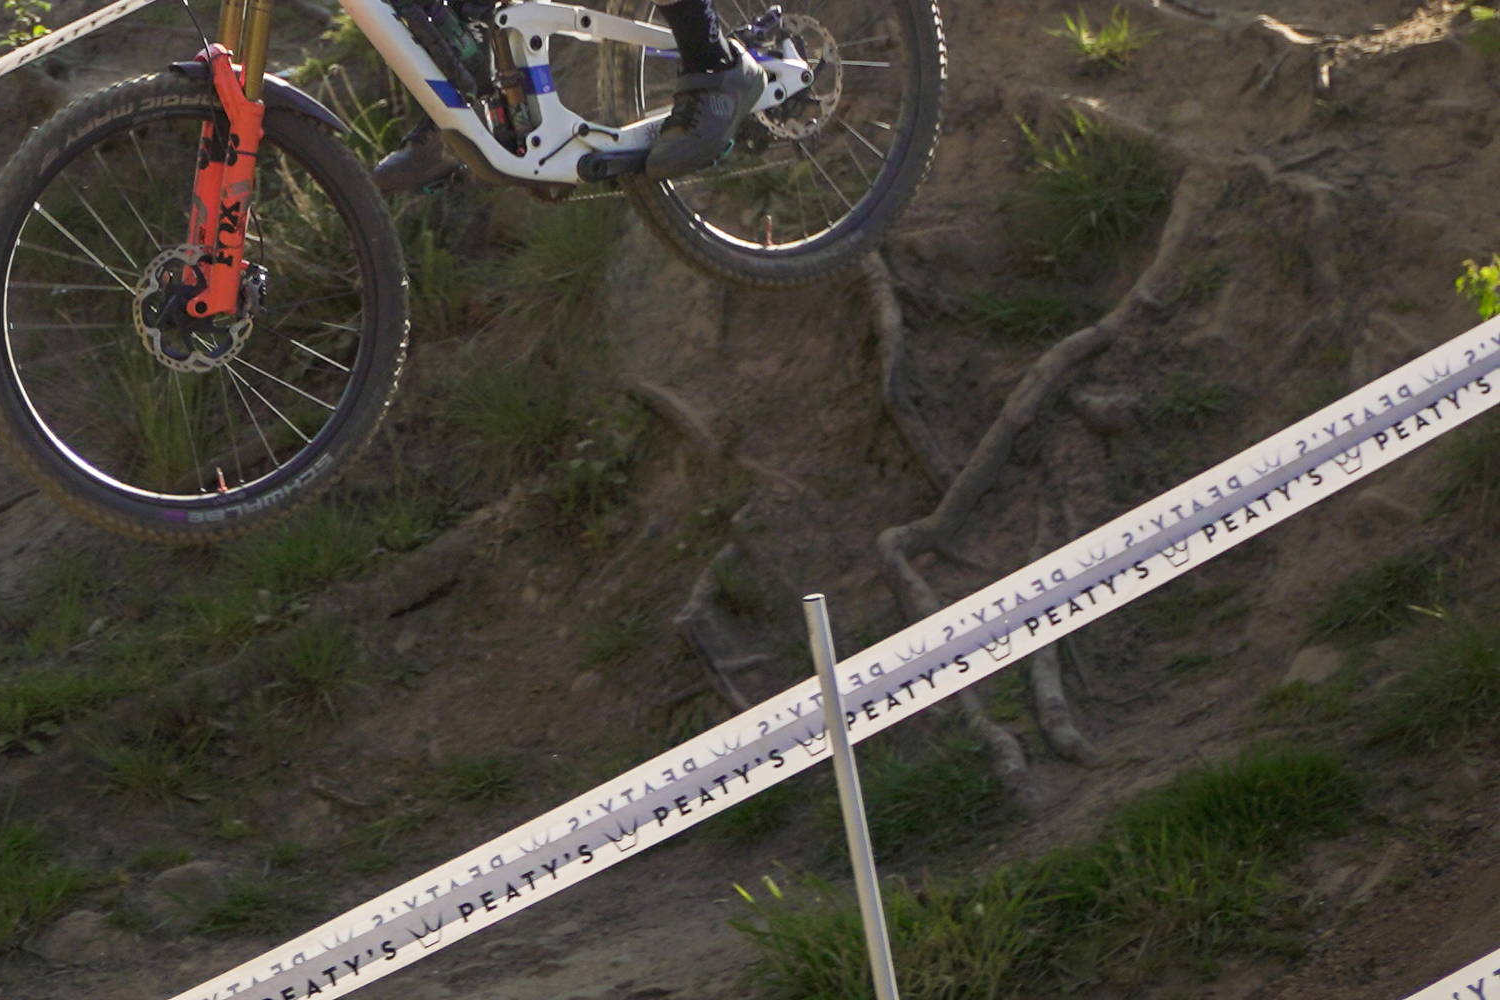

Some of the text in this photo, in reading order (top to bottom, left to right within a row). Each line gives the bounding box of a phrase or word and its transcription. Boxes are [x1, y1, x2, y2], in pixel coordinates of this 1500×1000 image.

[215, 201, 241, 267] FOX
[186, 451, 334, 524] SCHWALBE
[263, 376, 1492, 1000] EATY'S PEATY'S PEATY'S PEATY'S PEATY'S PEATY'S PEATY'S
